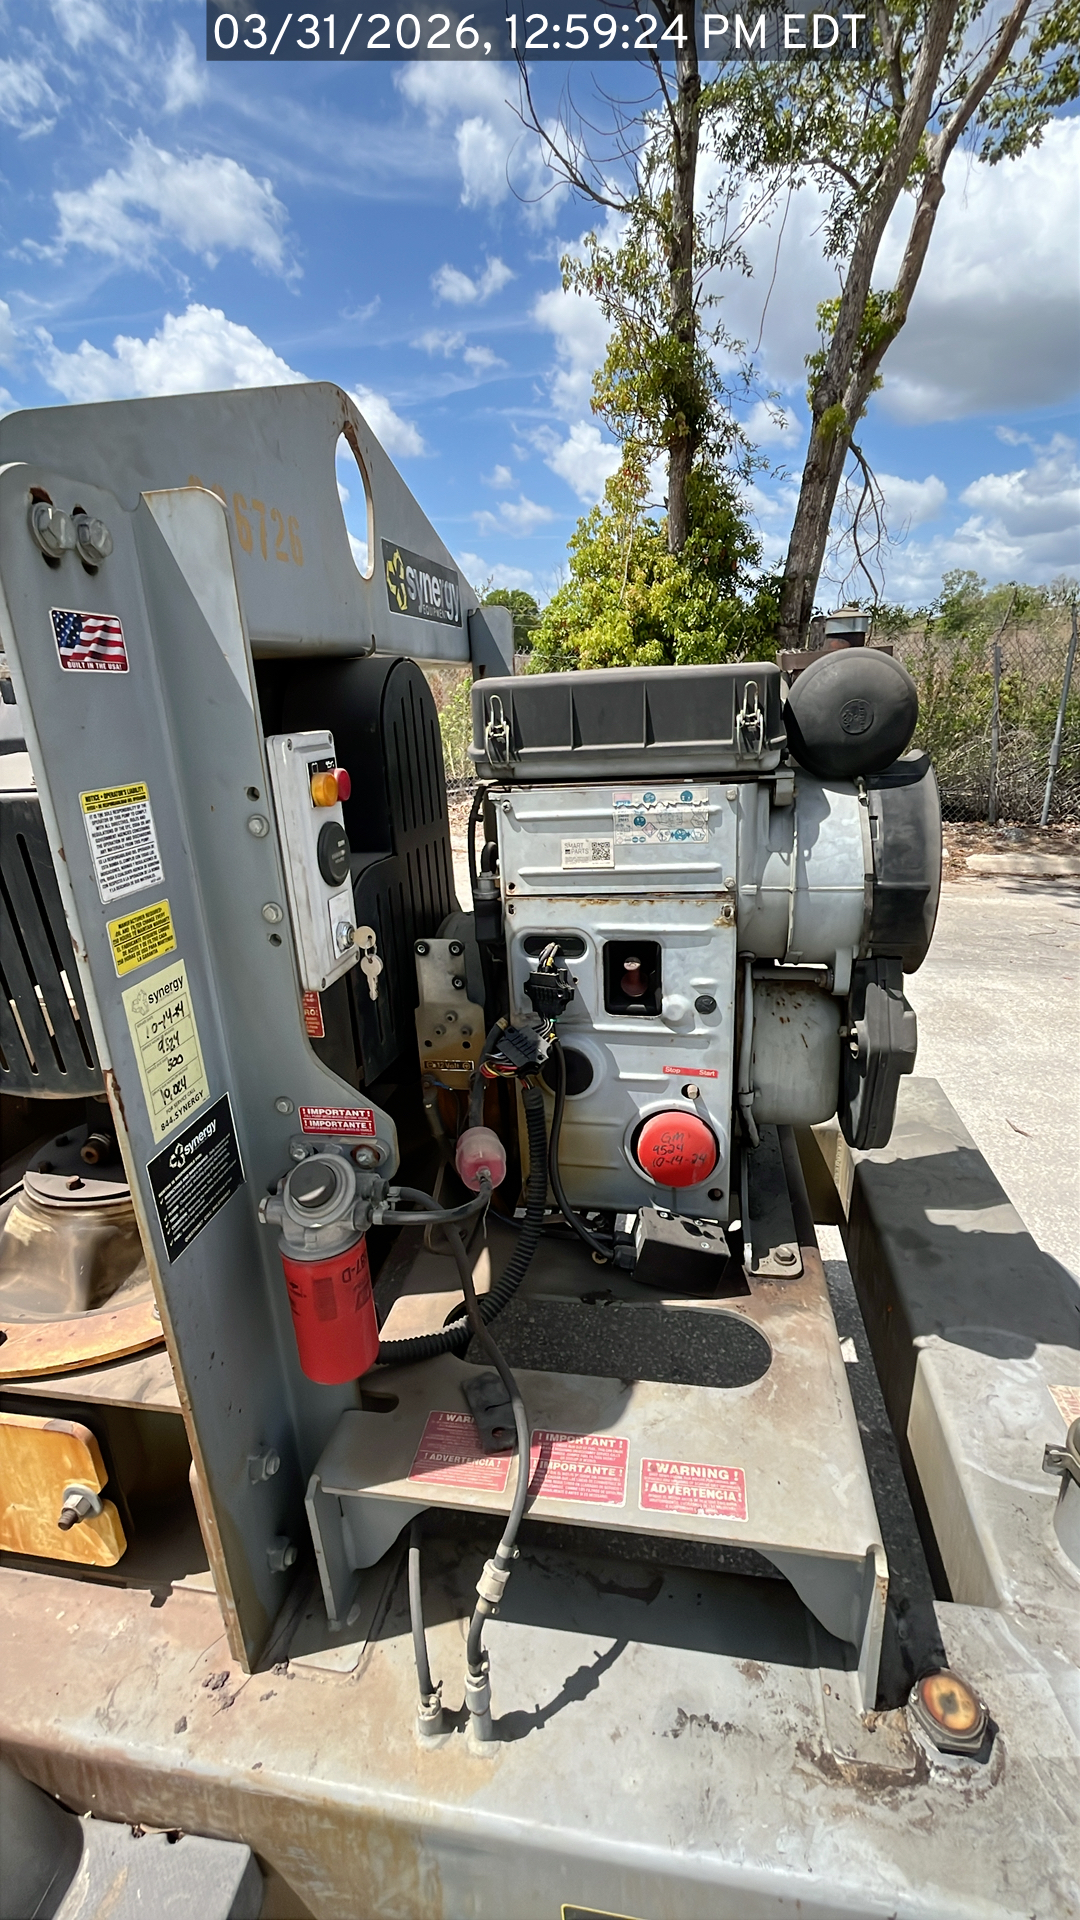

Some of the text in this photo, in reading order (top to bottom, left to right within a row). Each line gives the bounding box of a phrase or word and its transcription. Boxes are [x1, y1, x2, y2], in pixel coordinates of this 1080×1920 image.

[405, 565, 460, 622] synergy
[67, 661, 85, 669] BUILT
[95, 662, 107, 670] THE
[148, 975, 183, 1004] synergy
[699, 1069, 715, 1077] Start
[160, 1089, 204, 1131] 844.SYNERGY
[307, 1109, 365, 1117] IMPORTANT
[309, 1120, 367, 1129] IMPORTANTE
[184, 1118, 217, 1155] synergy
[660, 1132, 685, 1144] GM
[652, 1144, 684, 1156] 9524
[652, 1153, 708, 1168] 10-14-24
[545, 1433, 616, 1448] IMPORTANT
[429, 1453, 495, 1468] ADVERTENCIA
[540, 1461, 616, 1476] IMPORTANTE
[656, 1462, 729, 1480] WARNING
[650, 1483, 737, 1502] ADVERTENCIA
